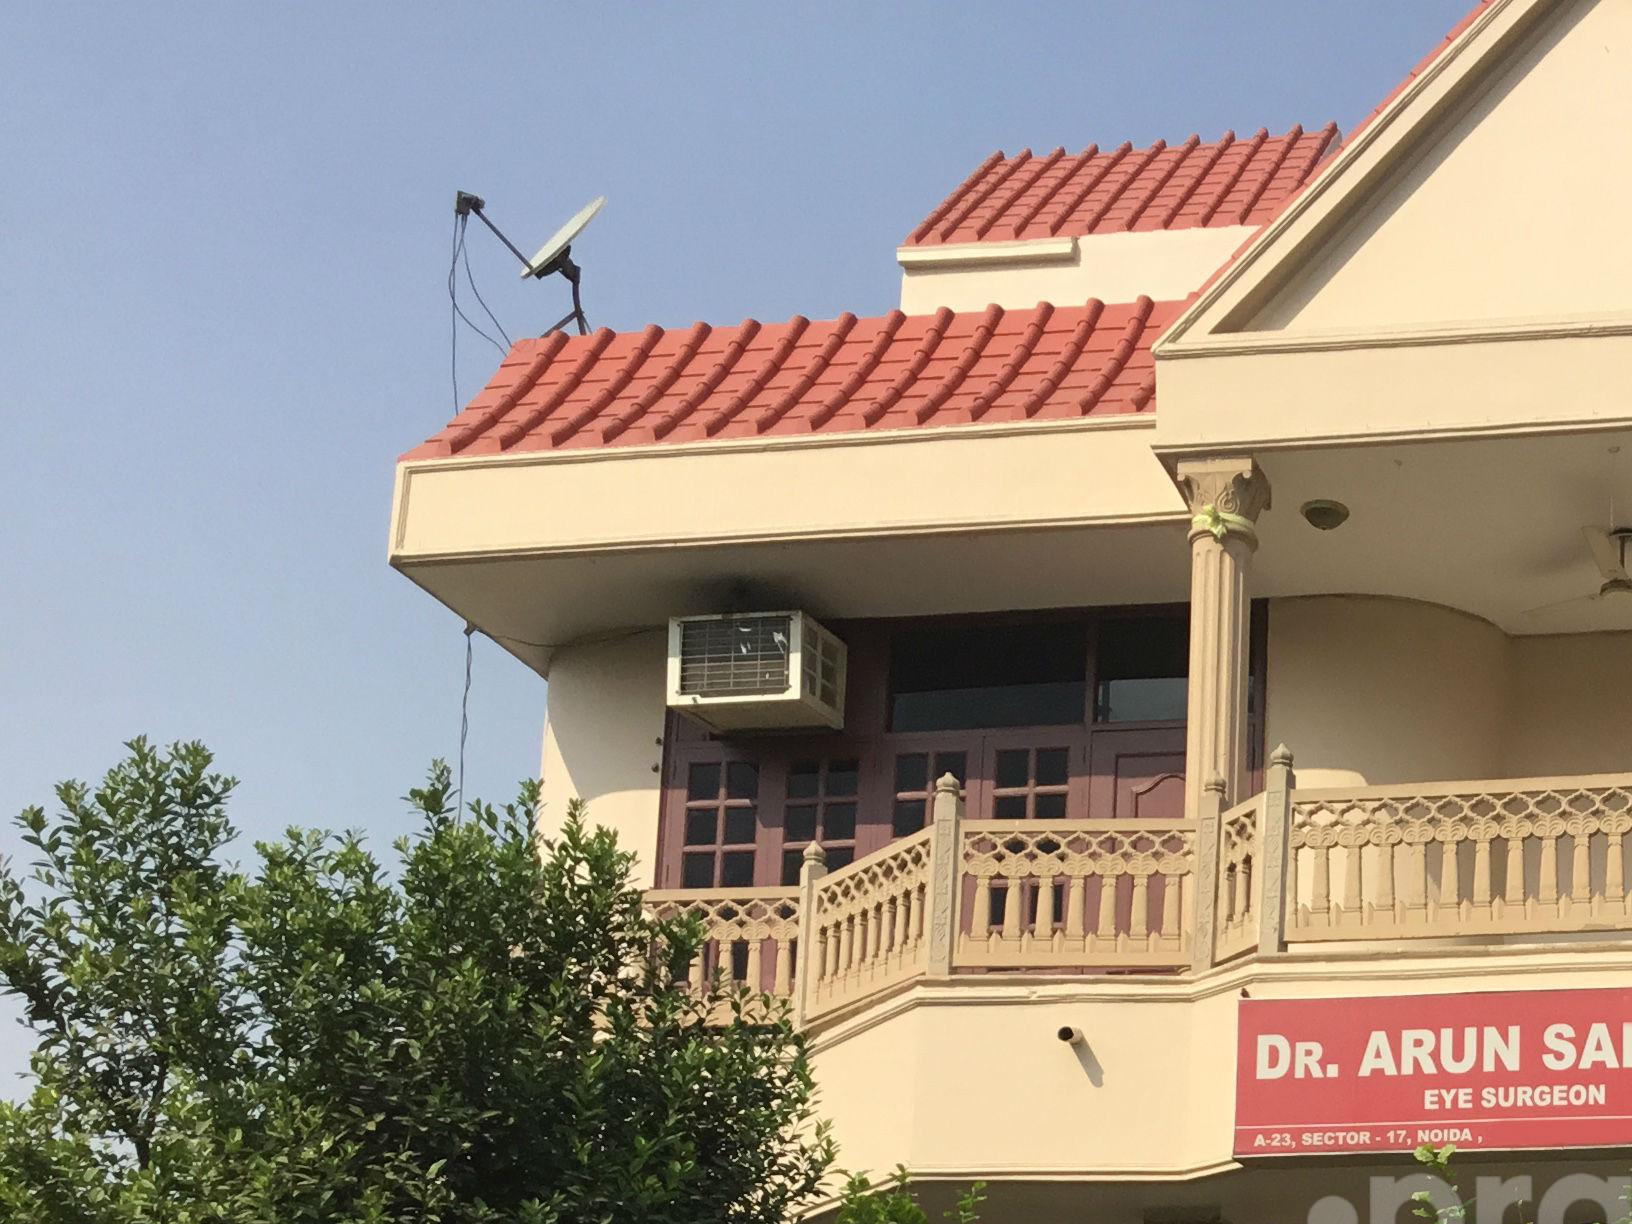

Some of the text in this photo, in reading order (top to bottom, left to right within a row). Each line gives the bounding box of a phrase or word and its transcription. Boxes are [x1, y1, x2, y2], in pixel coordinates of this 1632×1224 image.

[1357, 1025, 1521, 1077] ARUN
[1423, 1084, 1605, 1110] EYE SURGEON
[1253, 1134, 1297, 1149] A-23,
[1301, 1130, 1372, 1146] SECTOR
[1386, 1129, 1412, 1146] 17,
[1416, 1128, 1473, 1143] NOIDA
